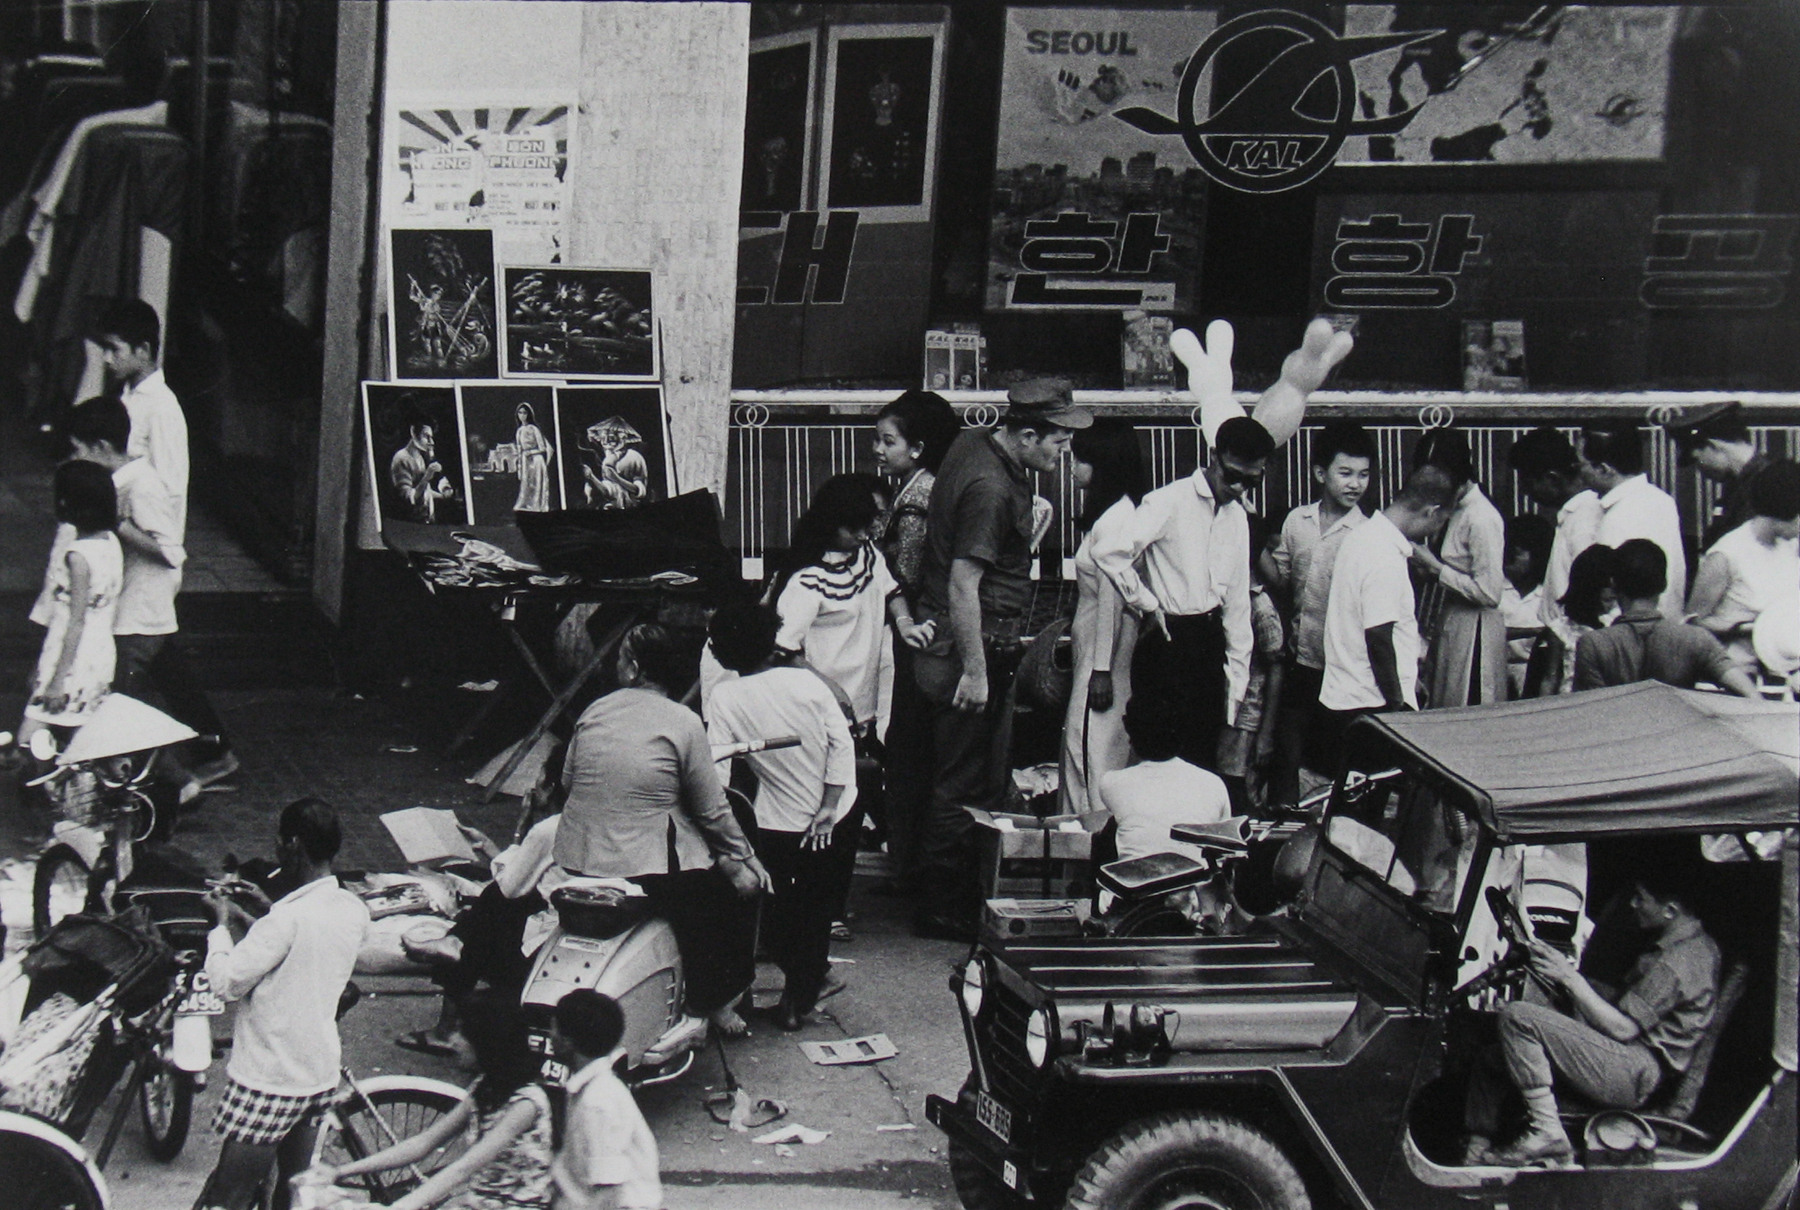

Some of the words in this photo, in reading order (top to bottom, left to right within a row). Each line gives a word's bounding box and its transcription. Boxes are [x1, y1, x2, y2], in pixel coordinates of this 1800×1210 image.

[1026, 30, 1137, 56] SEOUL
[1225, 140, 1303, 170] KAL
[1530, 914, 1570, 925] ONDA
